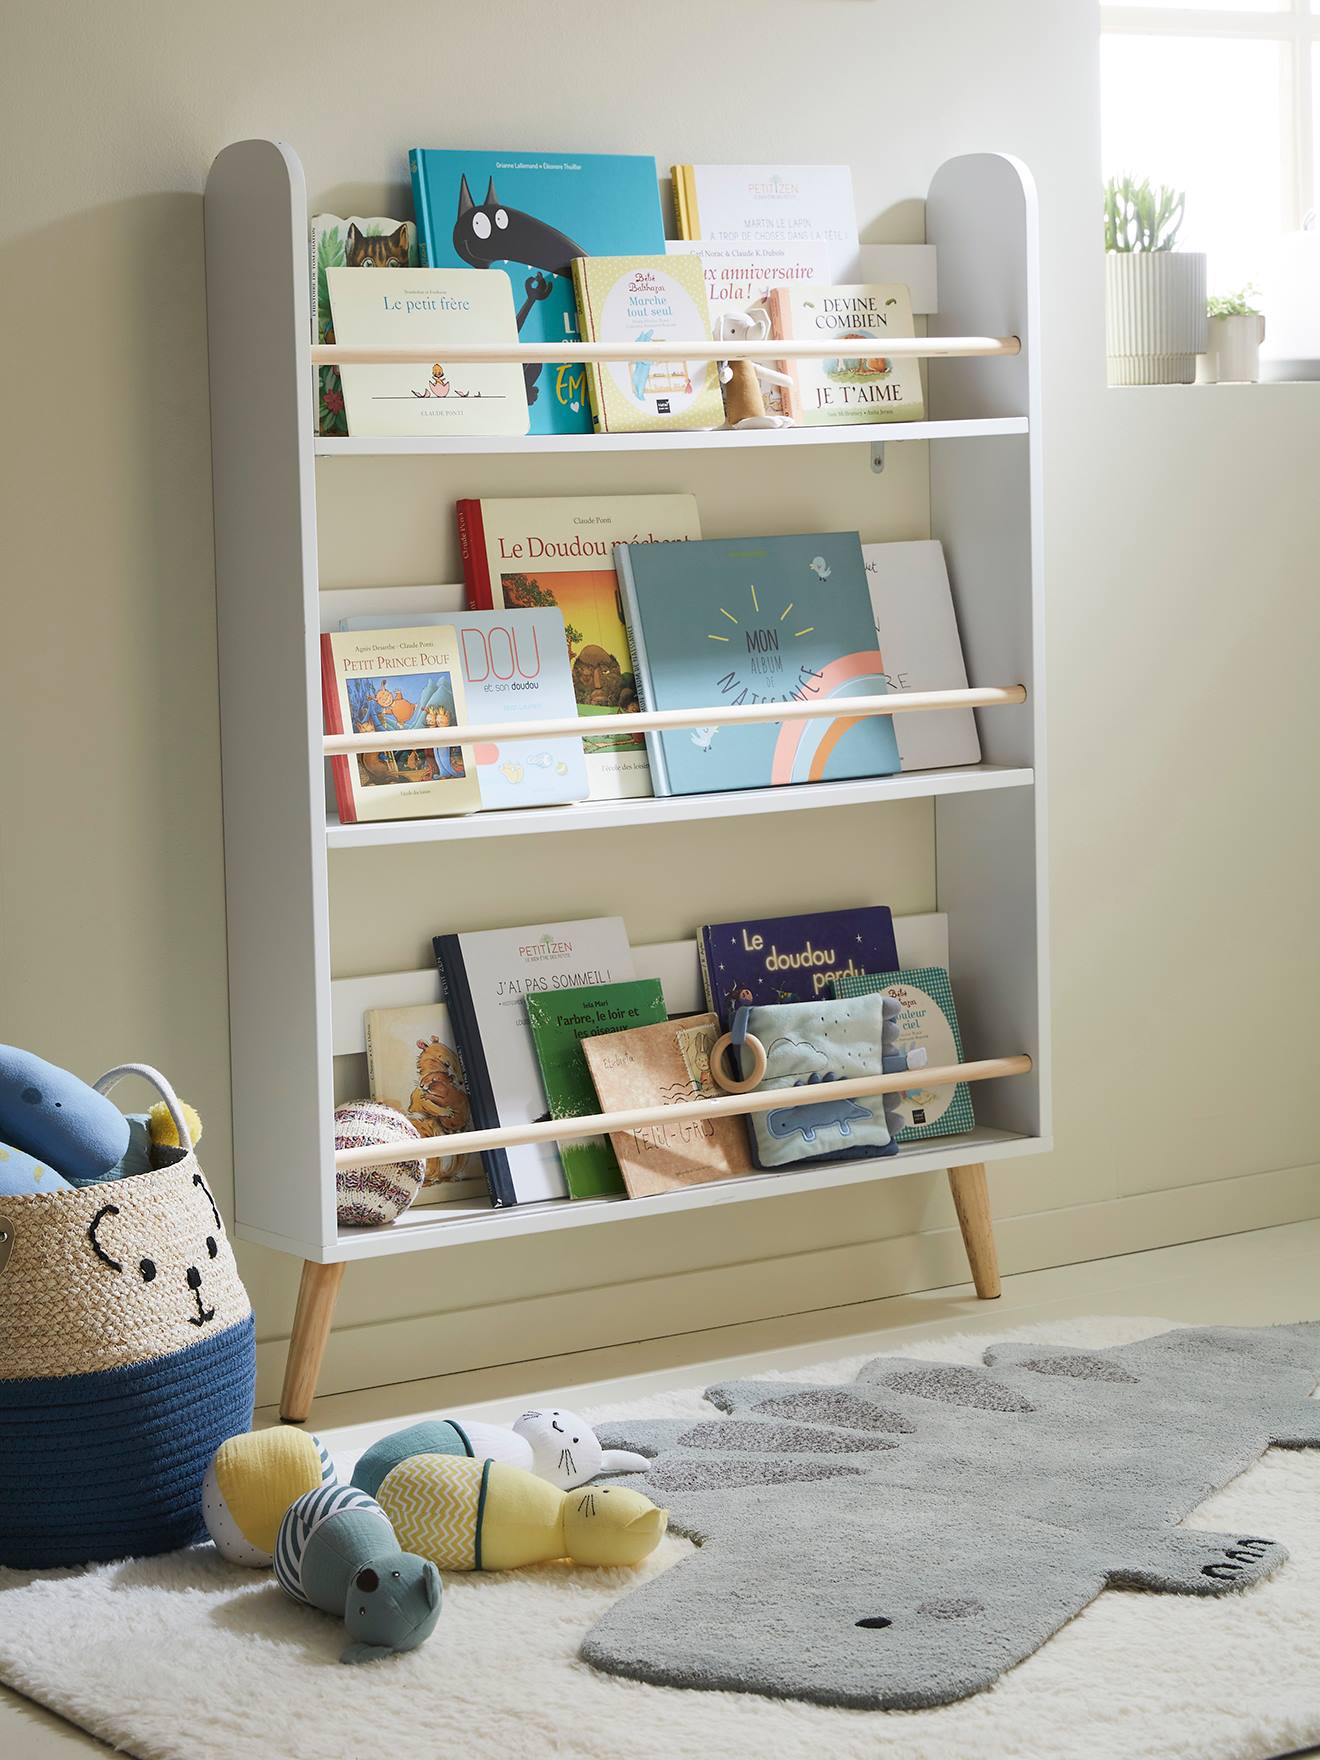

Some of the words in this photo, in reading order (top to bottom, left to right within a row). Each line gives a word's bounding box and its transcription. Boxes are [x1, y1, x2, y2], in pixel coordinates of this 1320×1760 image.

[721, 263, 814, 280] anniversaire
[383, 296, 402, 310] Le
[406, 296, 437, 314] petit
[440, 296, 470, 311] frère
[629, 296, 666, 306] Marche
[823, 297, 878, 312] DEVINE
[627, 307, 648, 317] tout
[651, 306, 673, 316] seul
[815, 313, 888, 329] COMBIEN
[816, 386, 834, 409] JE
[839, 384, 903, 403] T'AIME
[573, 516, 595, 525] Claude
[498, 537, 524, 559] Le
[526, 535, 608, 558] Doudou
[745, 628, 779, 654] MON
[343, 657, 374, 671] PETIT
[377, 656, 418, 669] PRINCE
[420, 653, 450, 666] POUF
[461, 625, 540, 682] DOU
[750, 655, 784, 675] ALBUM
[483, 684, 494, 692] et
[495, 683, 510, 692] son
[511, 681, 539, 691] doudou
[742, 928, 764, 951] Le
[765, 941, 836, 972] doudou
[496, 980, 522, 996] J'AI
[525, 977, 548, 992] PAS
[557, 1013, 595, 1027] l'arbre,
[596, 1011, 607, 1021] le
[608, 1008, 625, 1020] loir
[628, 1008, 640, 1017] et
[902, 1018, 920, 1031] ciel
[574, 1028, 589, 1039] les
